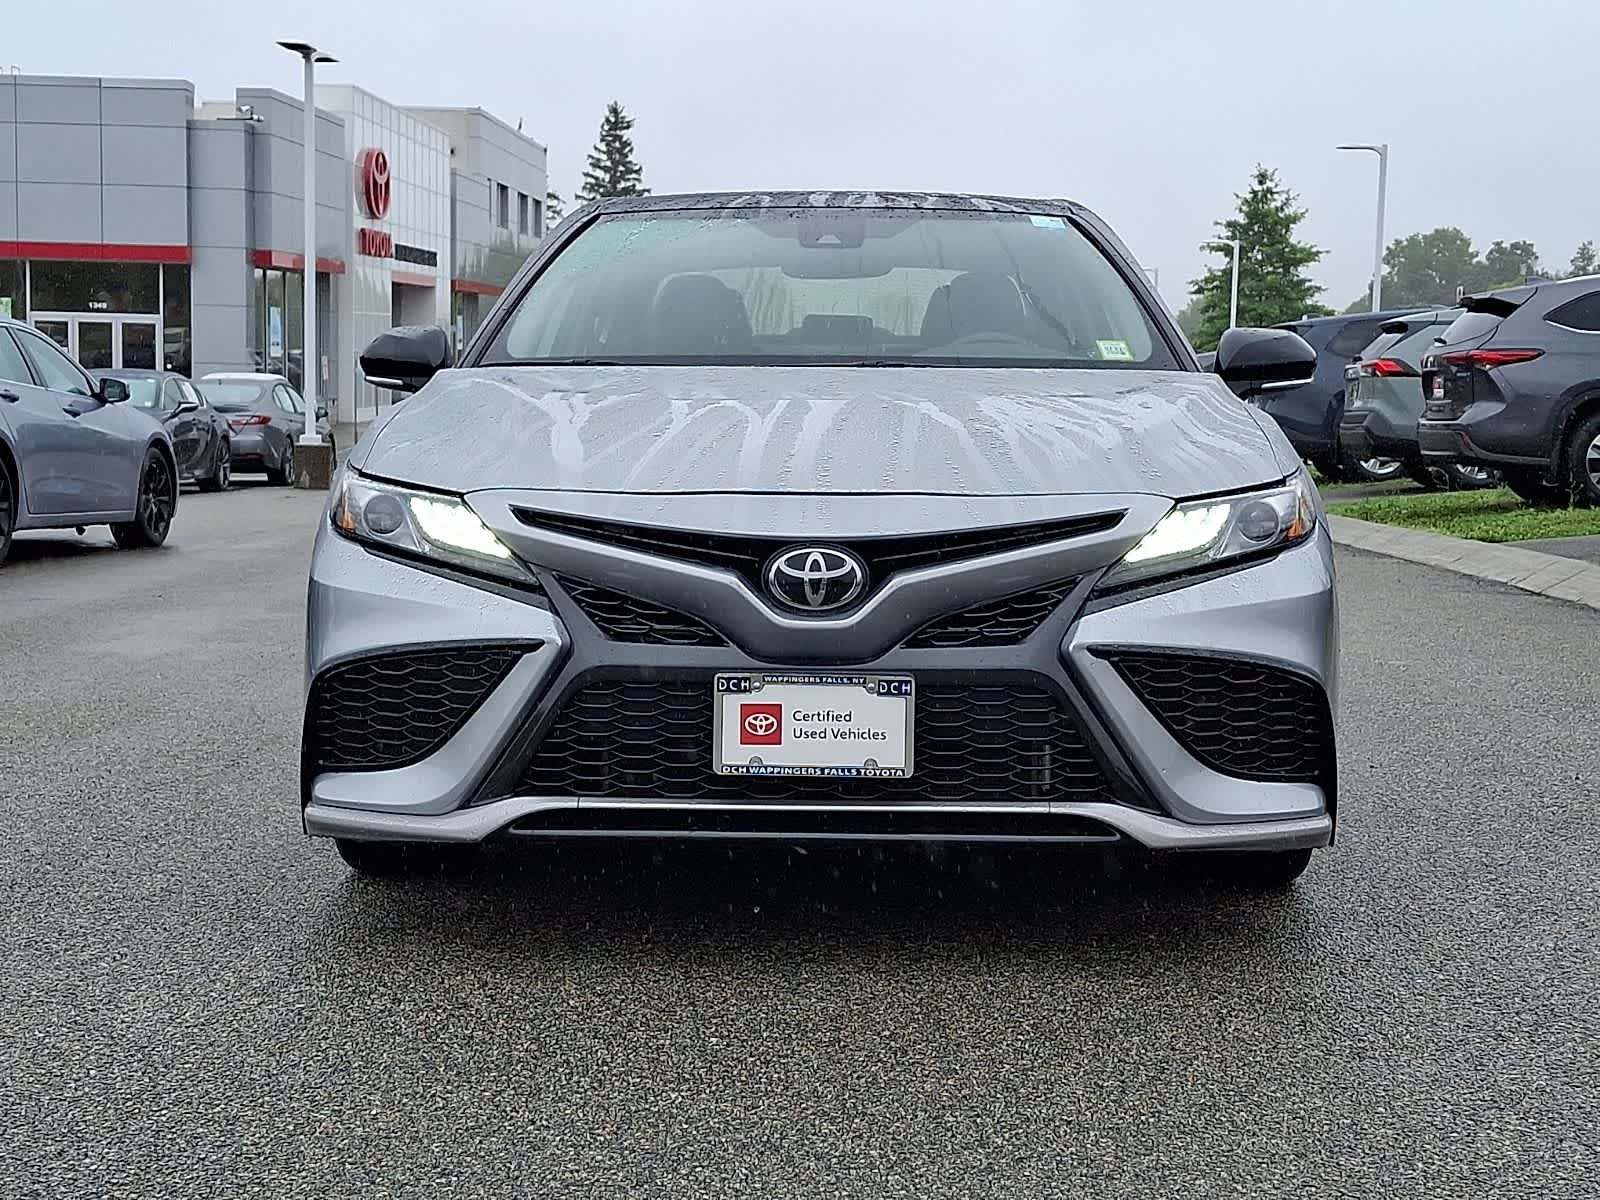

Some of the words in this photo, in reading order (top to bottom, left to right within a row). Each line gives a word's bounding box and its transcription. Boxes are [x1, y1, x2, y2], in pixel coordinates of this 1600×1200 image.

[363, 229, 393, 257] TOYOTA
[719, 679, 750, 691] DCH
[763, 675, 820, 683] WAPPINGERS
[879, 681, 911, 694] DCH
[792, 710, 852, 722] Certified
[792, 728, 827, 740] Used
[831, 728, 887, 741] Vehicles
[749, 766, 821, 775] WAPPINGERS
[824, 768, 858, 776] FALLS
[860, 769, 904, 777] TOYOTA
